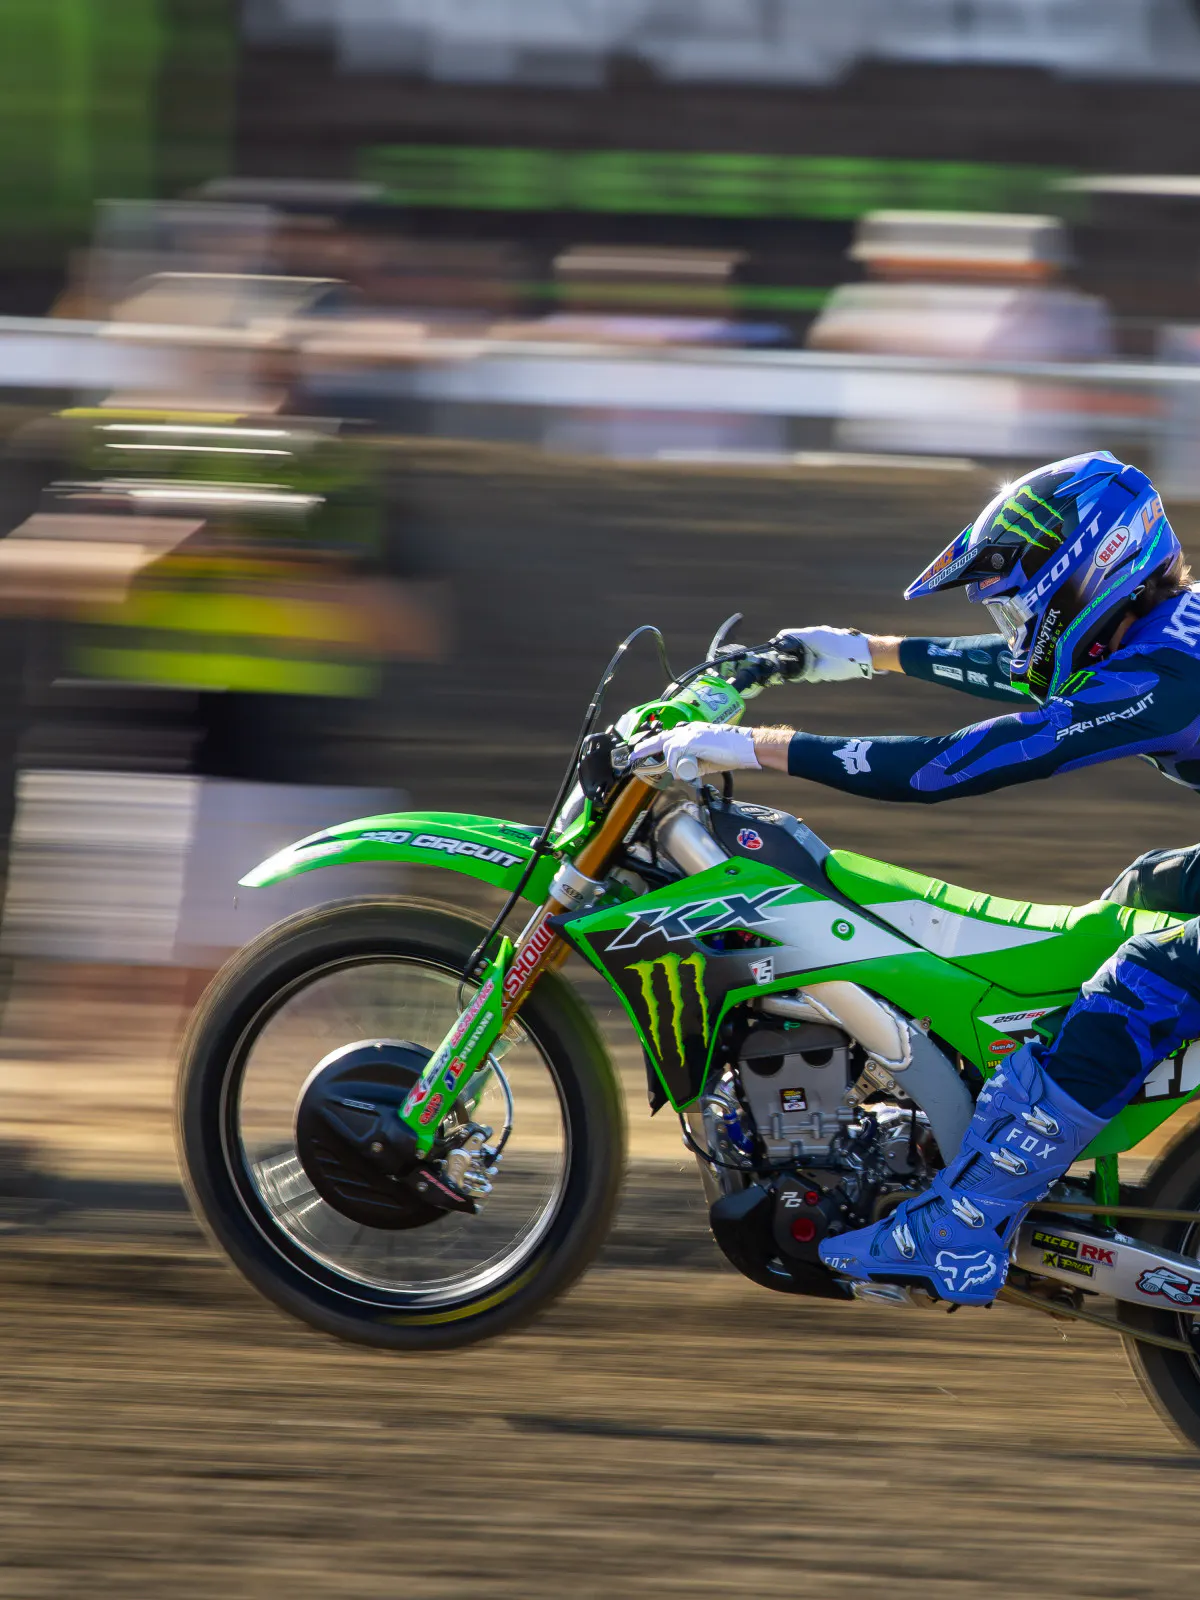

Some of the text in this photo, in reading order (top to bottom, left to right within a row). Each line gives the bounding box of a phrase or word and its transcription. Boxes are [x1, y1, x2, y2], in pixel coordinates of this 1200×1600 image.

[1022, 511, 1102, 609] SCOTT
[1098, 533, 1127, 563] BELL
[1031, 608, 1061, 665] MONSTER
[1056, 719, 1095, 741] PRO
[1095, 692, 1154, 726] CIRCUIT
[411, 834, 524, 868] CIRCUIT
[604, 883, 804, 952] KX
[459, 1011, 494, 1060] PISTONS
[1006, 1127, 1057, 1160] FOX
[1034, 1233, 1077, 1250] EXCEL
[1081, 1243, 1116, 1264] RK
